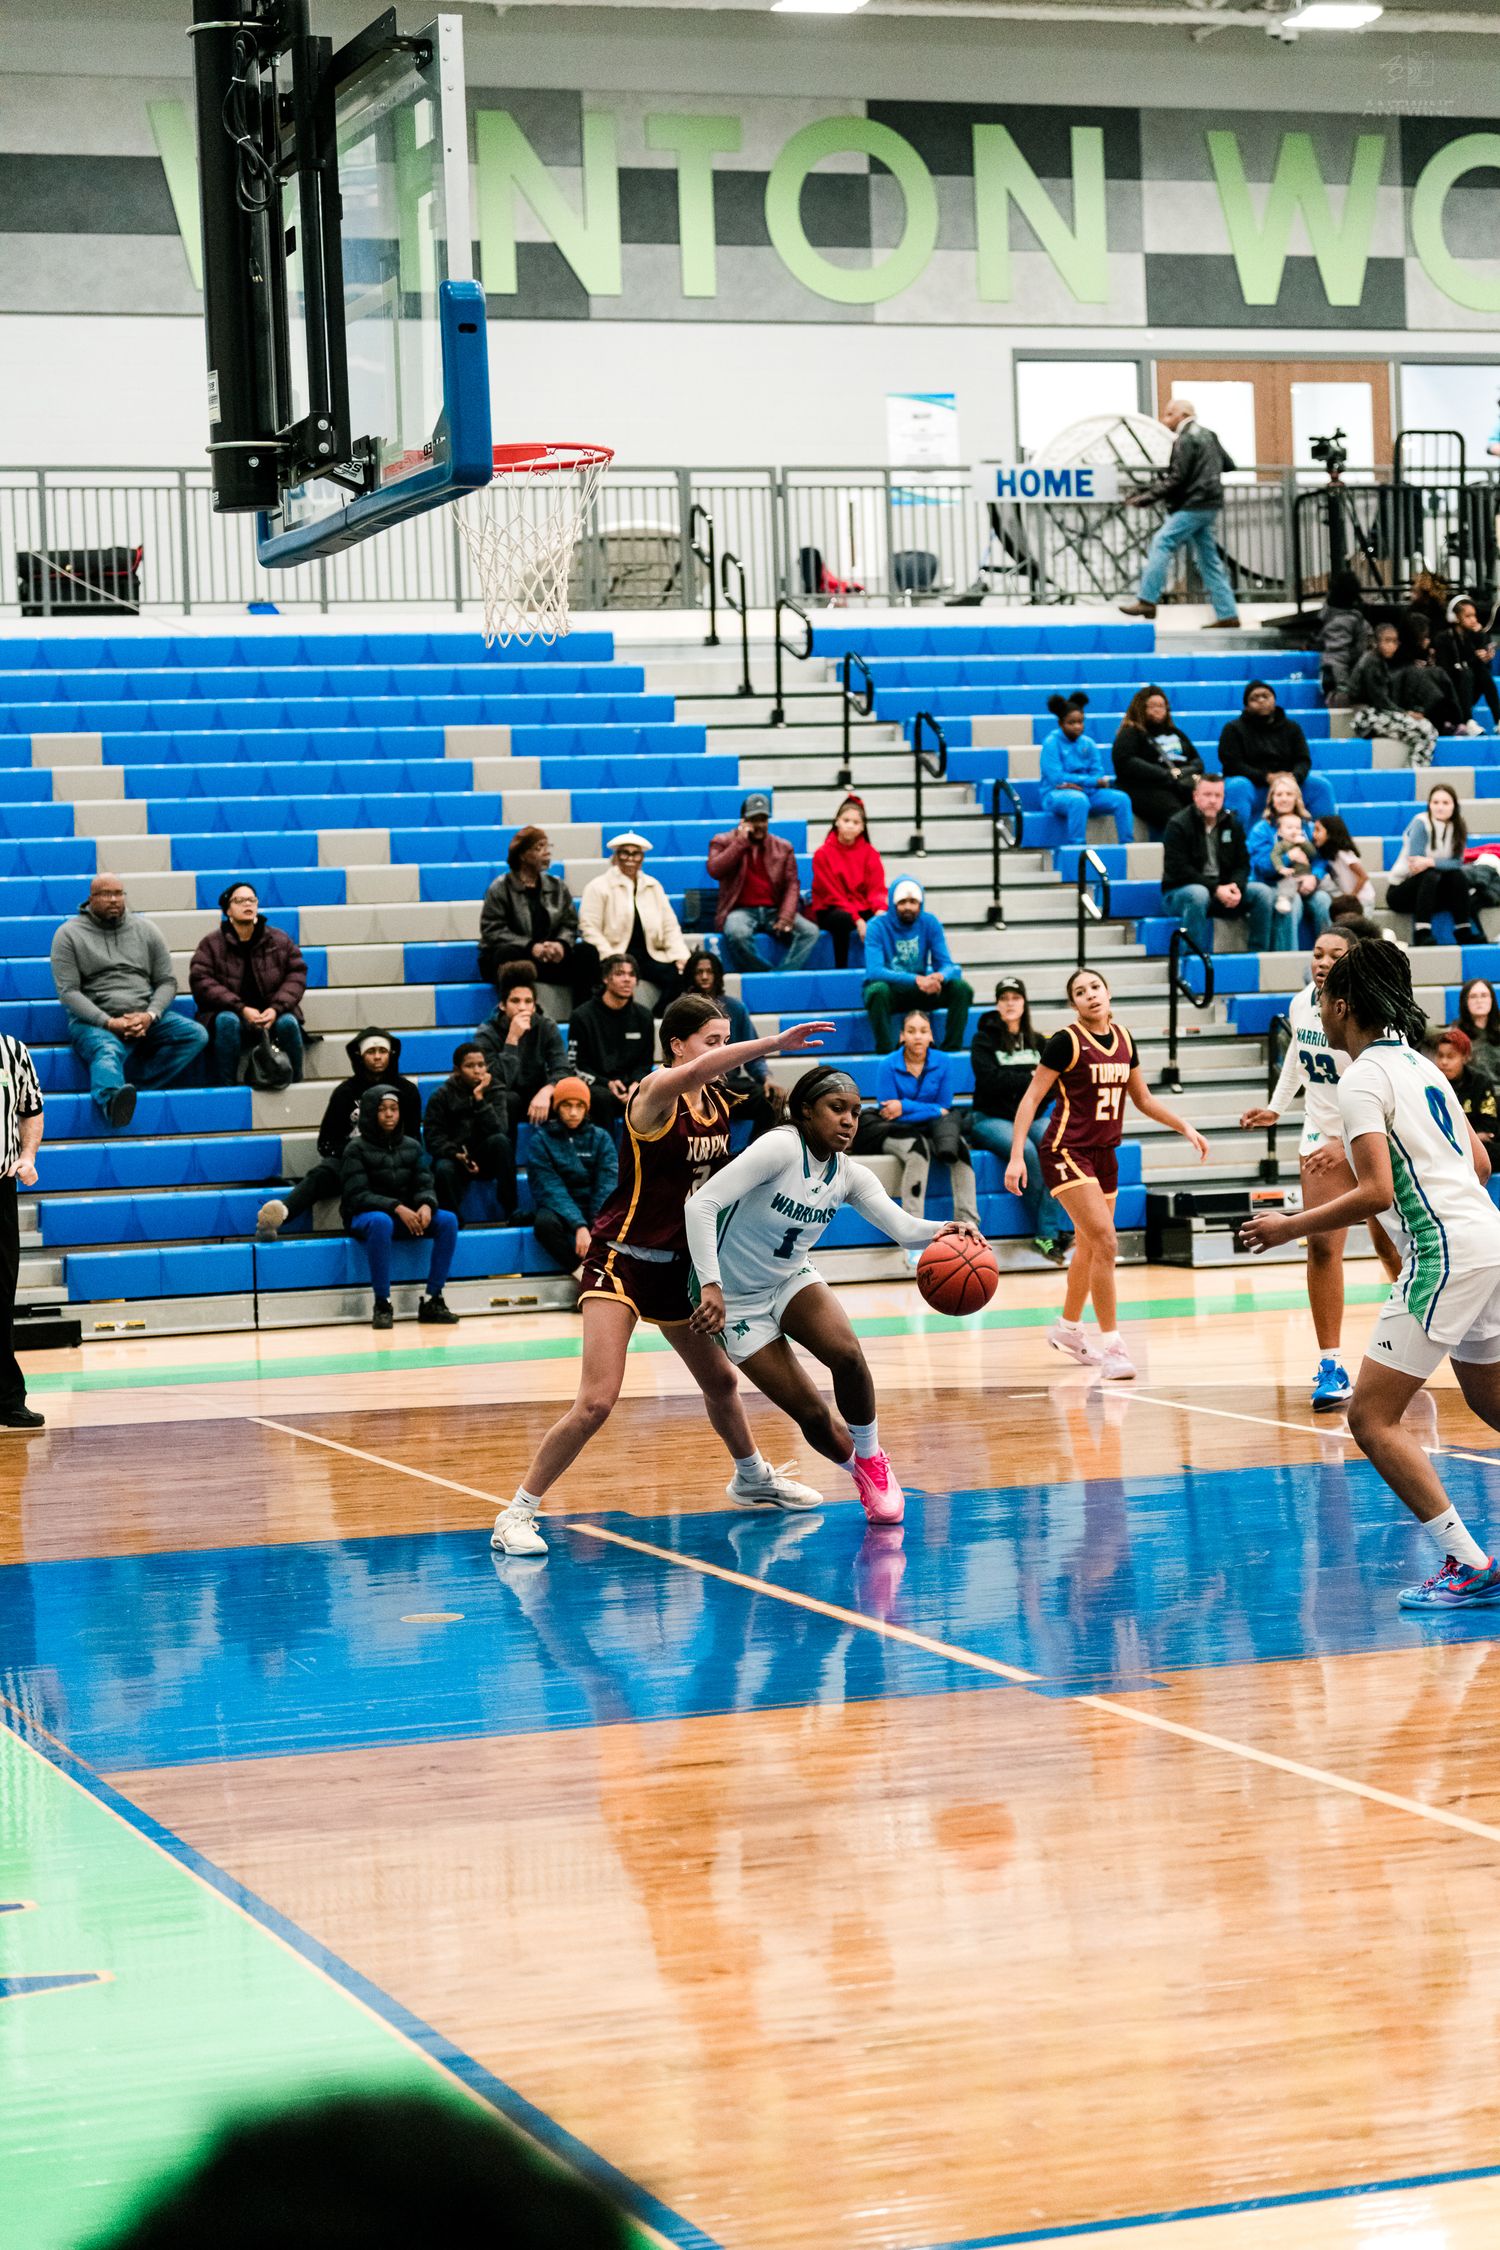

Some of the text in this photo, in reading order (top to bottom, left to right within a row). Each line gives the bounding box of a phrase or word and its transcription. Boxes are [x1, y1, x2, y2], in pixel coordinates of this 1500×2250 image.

[997, 469, 1094, 497] HOME
[1298, 1050, 1340, 1084] 23
[1095, 1087, 1122, 1121] 24
[773, 1227, 804, 1260] 1
